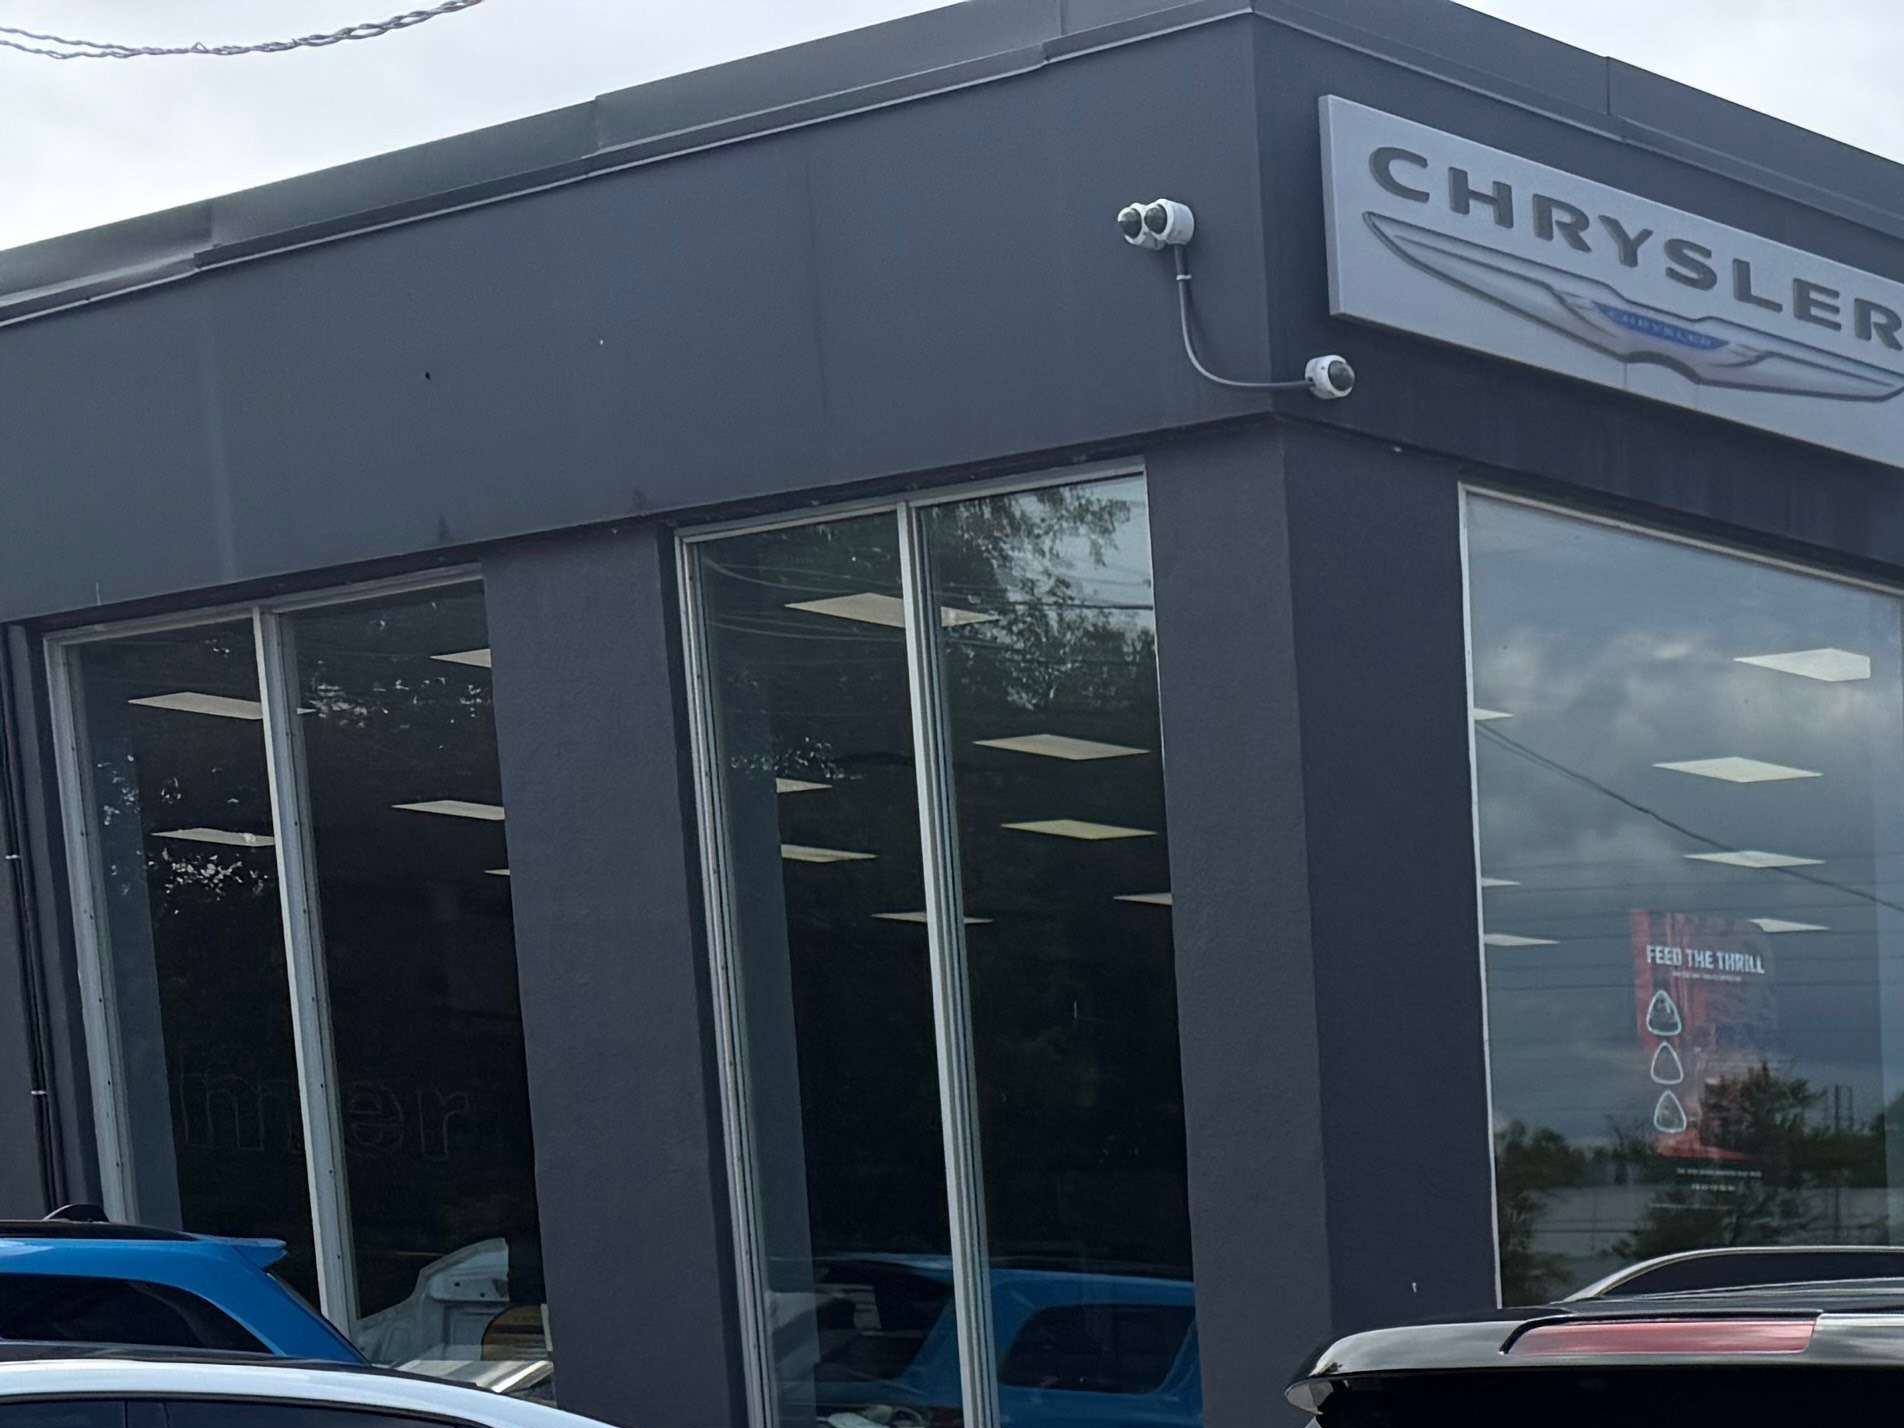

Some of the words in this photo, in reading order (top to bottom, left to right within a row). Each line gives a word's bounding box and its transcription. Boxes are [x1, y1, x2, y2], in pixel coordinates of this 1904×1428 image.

[1369, 146, 1904, 351] CHRYSLER
[1646, 945, 1682, 966] FEED
[1685, 949, 1714, 969] THE
[1716, 951, 1765, 974] THRILL
